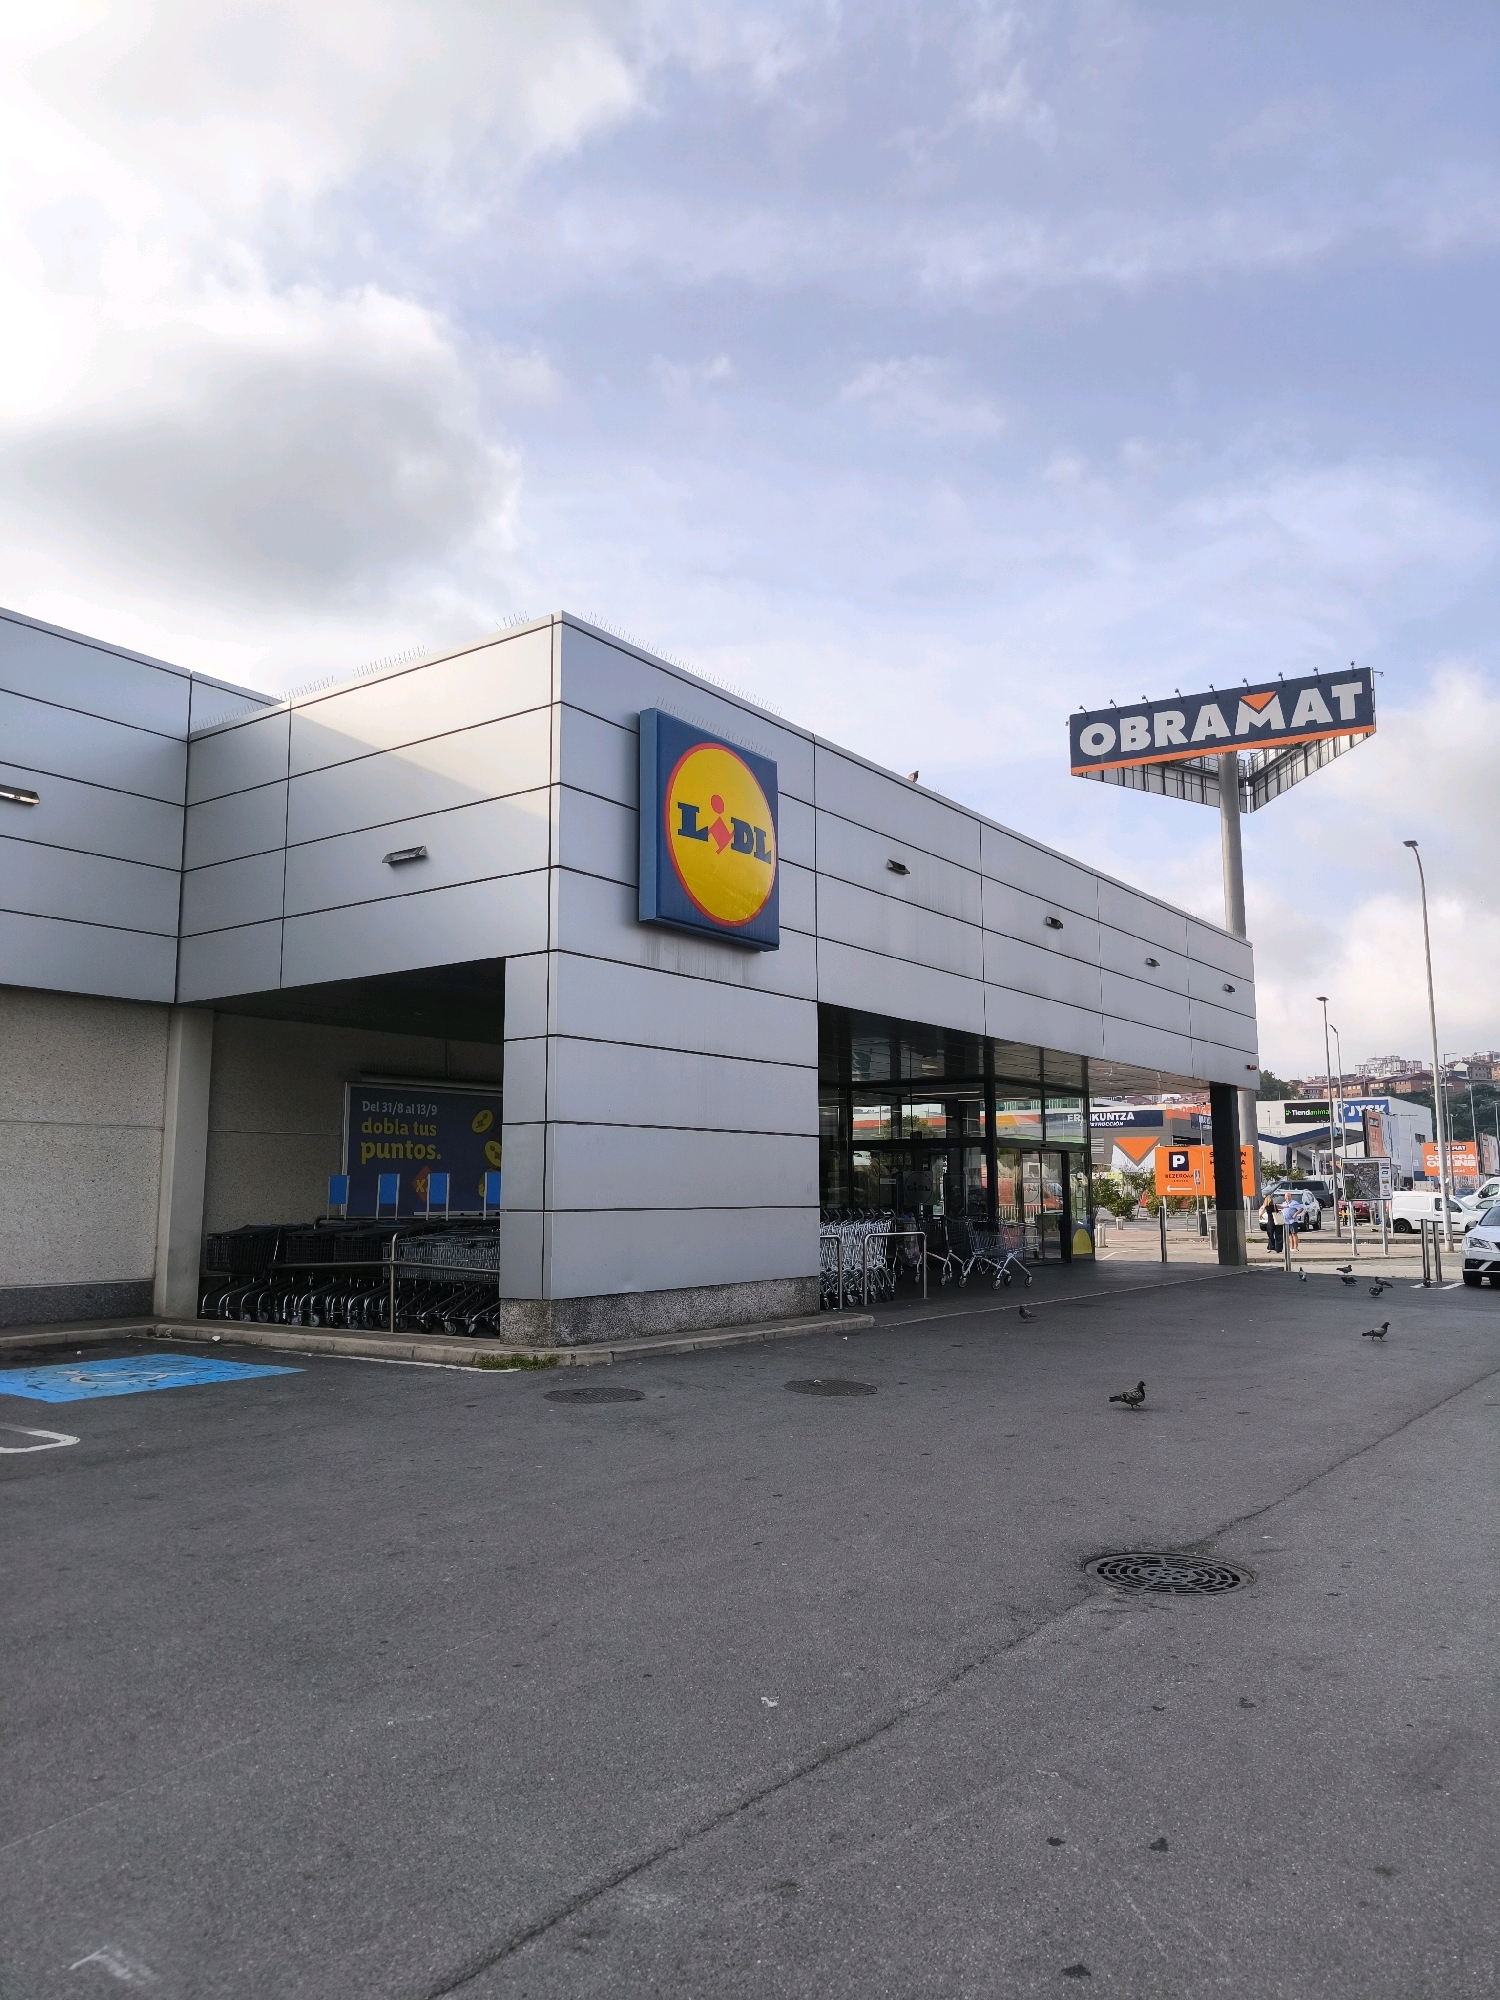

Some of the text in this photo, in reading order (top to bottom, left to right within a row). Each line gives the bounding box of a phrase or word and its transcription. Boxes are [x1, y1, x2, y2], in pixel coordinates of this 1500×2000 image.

[1079, 682, 1362, 757] OBRAMAT
[362, 1100, 438, 1117] Del 31/8 al 13/9
[1291, 1108, 1330, 1116] Tiendanima
[1348, 1104, 1386, 1117] JYSK
[360, 1117, 437, 1136] dobla tus
[360, 1140, 442, 1164] puntos.
[1172, 1154, 1186, 1168] P
